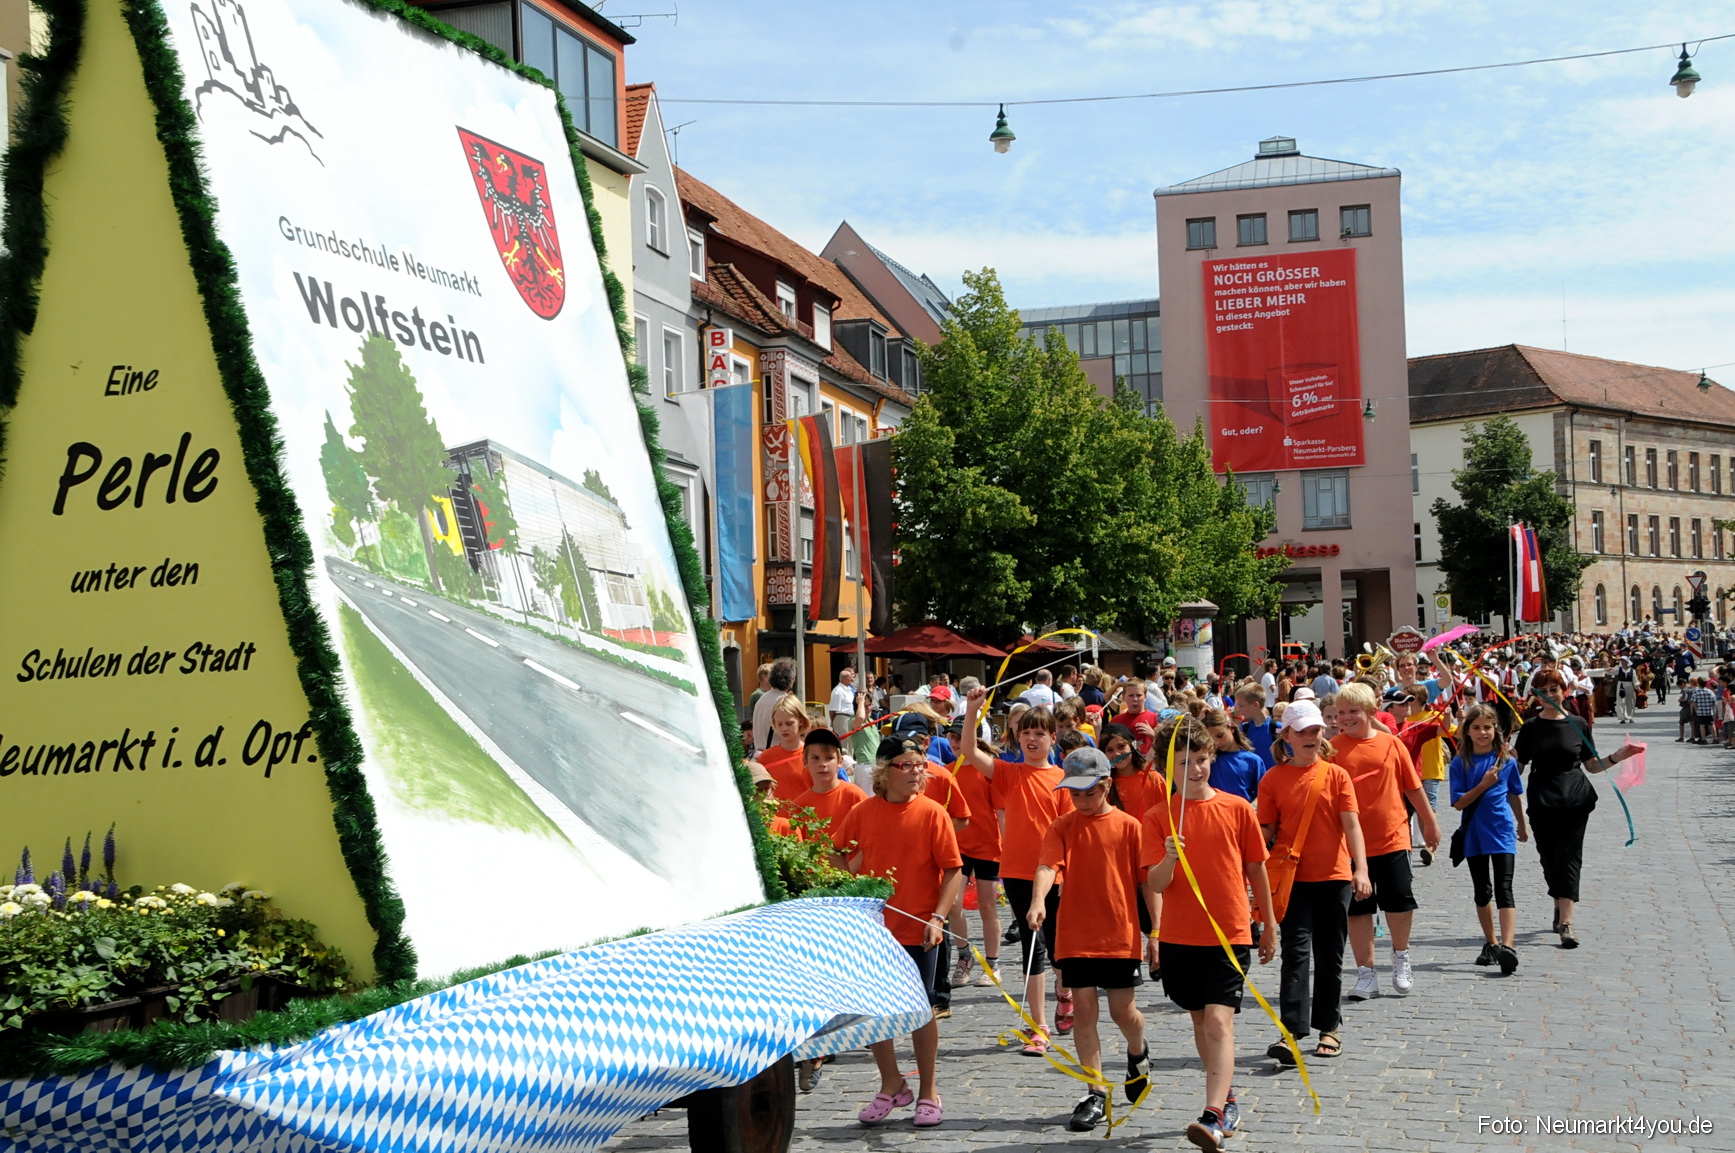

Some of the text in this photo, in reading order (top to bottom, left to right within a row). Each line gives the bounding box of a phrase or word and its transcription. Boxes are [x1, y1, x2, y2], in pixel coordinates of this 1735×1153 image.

[278, 215, 482, 297] Grundschule Neumarkt
[1213, 264, 1228, 272] Wir
[1230, 263, 1257, 271] hätten
[1214, 267, 1320, 286] NOCH GRÖSSER
[1215, 287, 1247, 296] machen
[1305, 281, 1318, 289] wir
[1319, 279, 1347, 287] haben
[1215, 293, 1306, 311] LIEBER MEHR
[292, 270, 485, 365] Wolfstein
[1226, 313, 1252, 321] dieses
[1254, 309, 1290, 320] Angebot
[1216, 322, 1254, 333] gesteckt:
[104, 365, 159, 397] Eine
[1291, 404, 1334, 417] Getränkemarke
[1222, 426, 1263, 437] Gut, oder?
[1293, 439, 1326, 447] Sparkasse
[1293, 445, 1356, 454] Neumarkt-Parsberg
[53, 431, 220, 516] Perle
[70, 557, 199, 593] unter den
[17, 641, 256, 683] Schulen der Stadt
[0, 719, 319, 778] eumarkt i. d. Opf.
